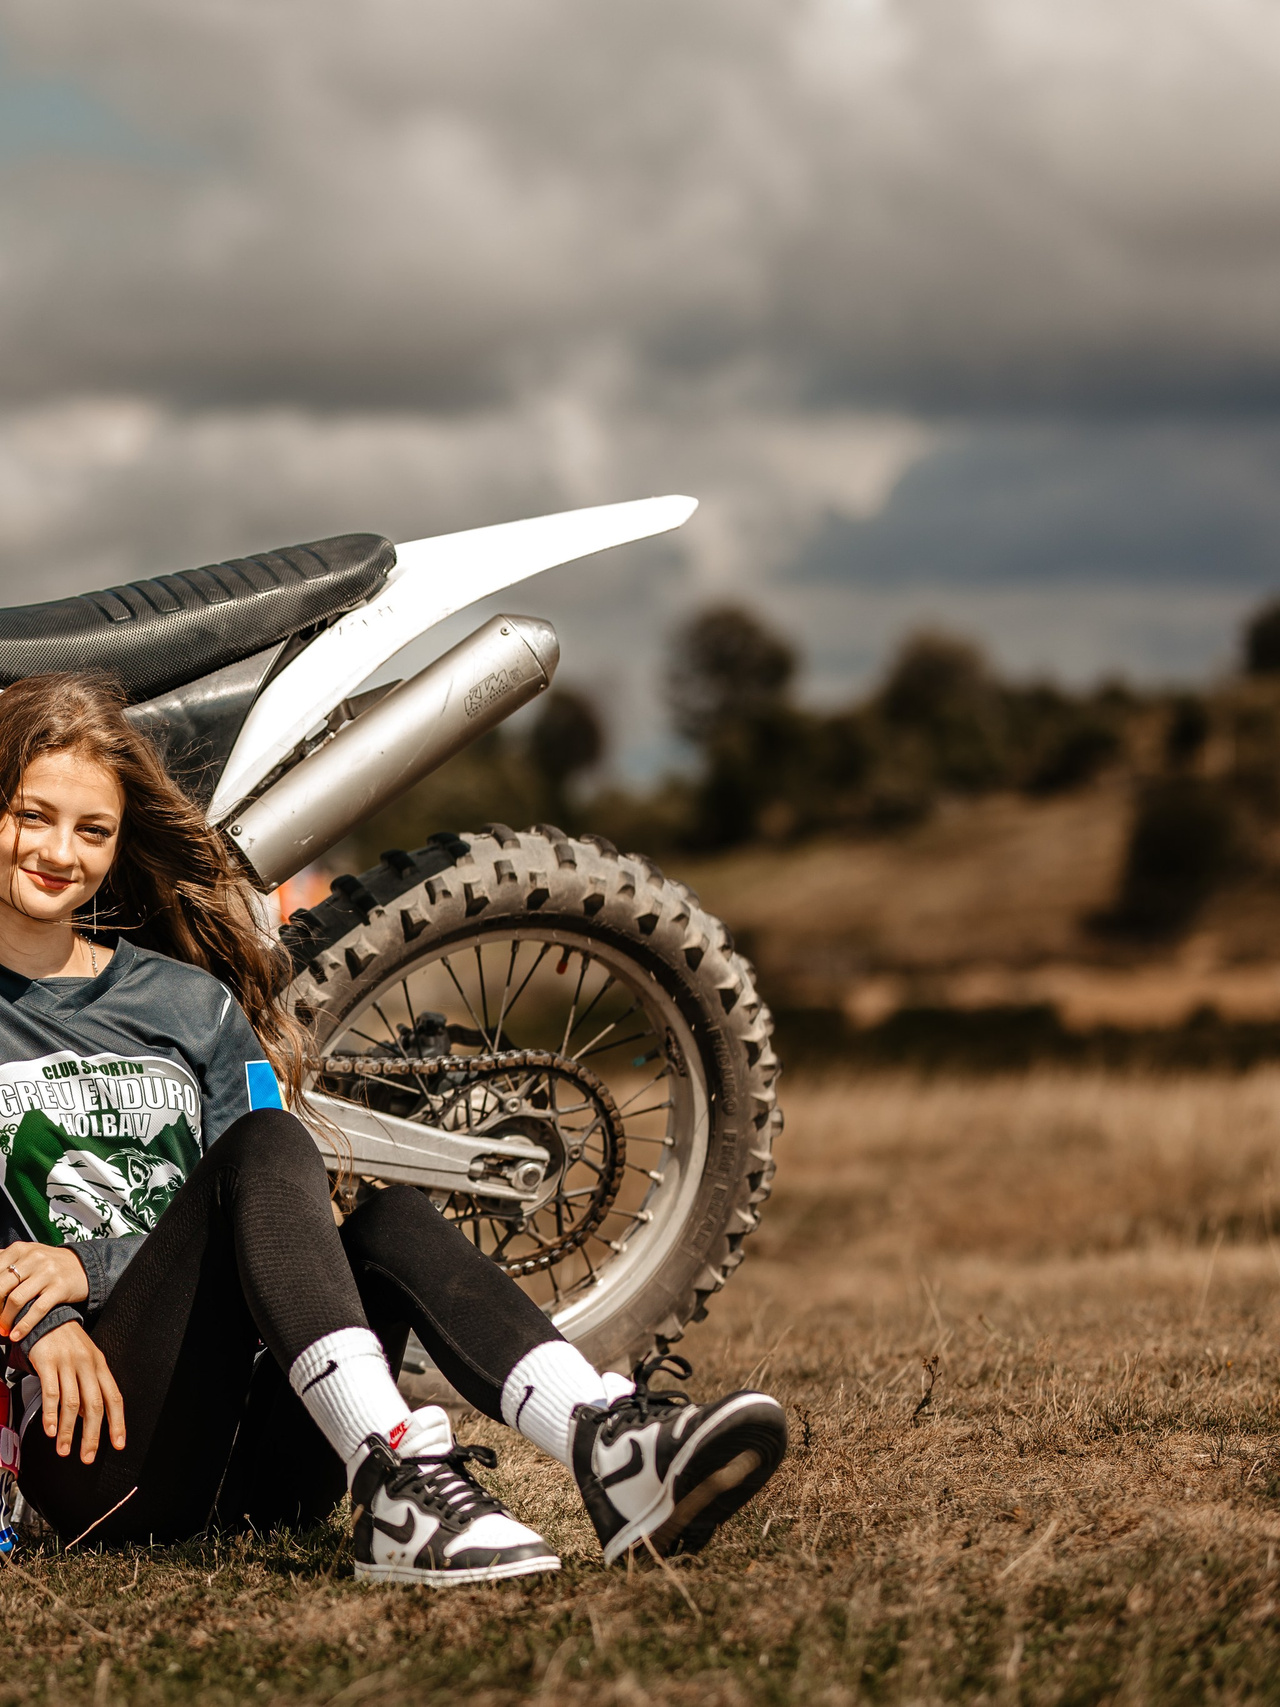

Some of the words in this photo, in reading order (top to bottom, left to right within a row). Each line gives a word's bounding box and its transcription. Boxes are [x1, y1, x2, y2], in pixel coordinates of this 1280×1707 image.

[464, 669, 508, 712] KTM
[41, 1060, 80, 1080] CLUB
[81, 1060, 144, 1077] SPORTIV
[79, 1076, 197, 1117] ENDURO
[59, 1113, 151, 1138] HOLBAV
[389, 1421, 406, 1441] NIKE
